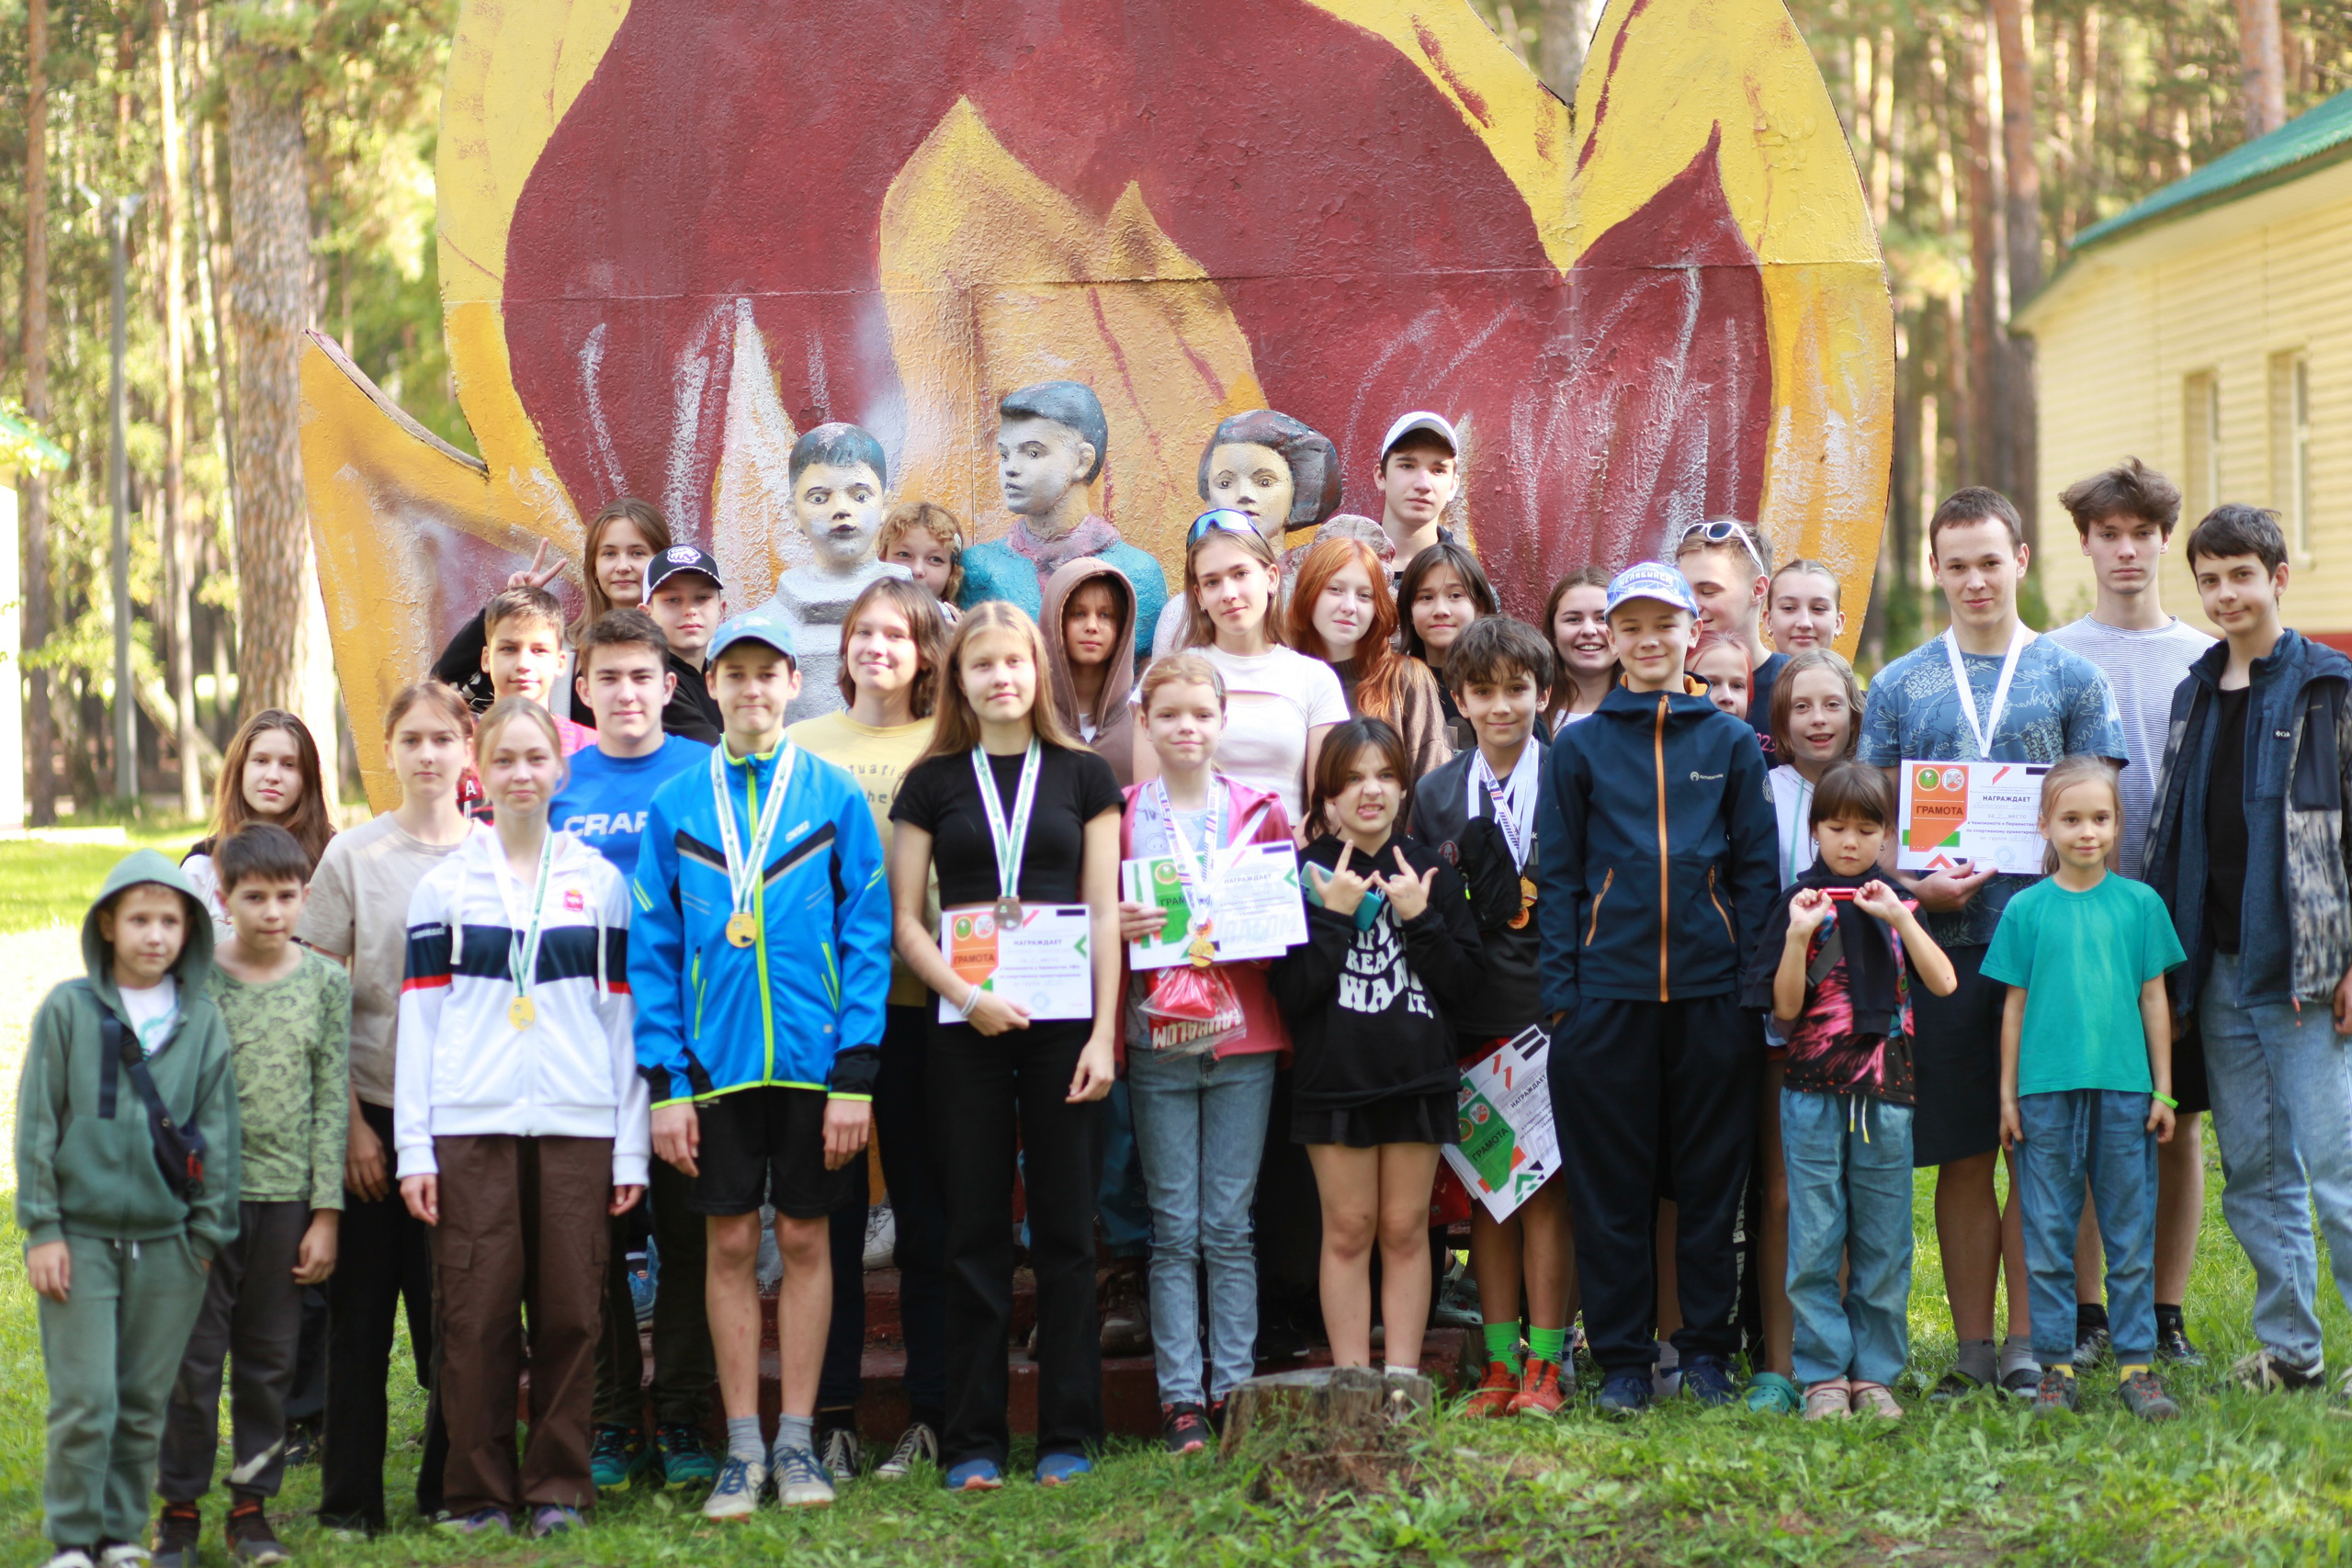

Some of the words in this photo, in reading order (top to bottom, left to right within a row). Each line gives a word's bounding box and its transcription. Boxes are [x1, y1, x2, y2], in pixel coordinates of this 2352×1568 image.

[1620, 571, 1673, 586] ЧЕЛЯБИНСК
[848, 764, 898, 776] tuari
[867, 791, 888, 804] he
[1917, 806, 1963, 816] ГРАМОТА
[563, 811, 649, 838] CRAF
[1224, 874, 1272, 885] НАГРАЖДАЕТ
[1160, 897, 1187, 908] ГРАМ
[1357, 929, 1375, 951] IF
[954, 953, 995, 964] ГРАМОТА
[1510, 1074, 1546, 1109] НАГРАЖДАЕТ
[1472, 1127, 1509, 1162] ГРАМОТА
